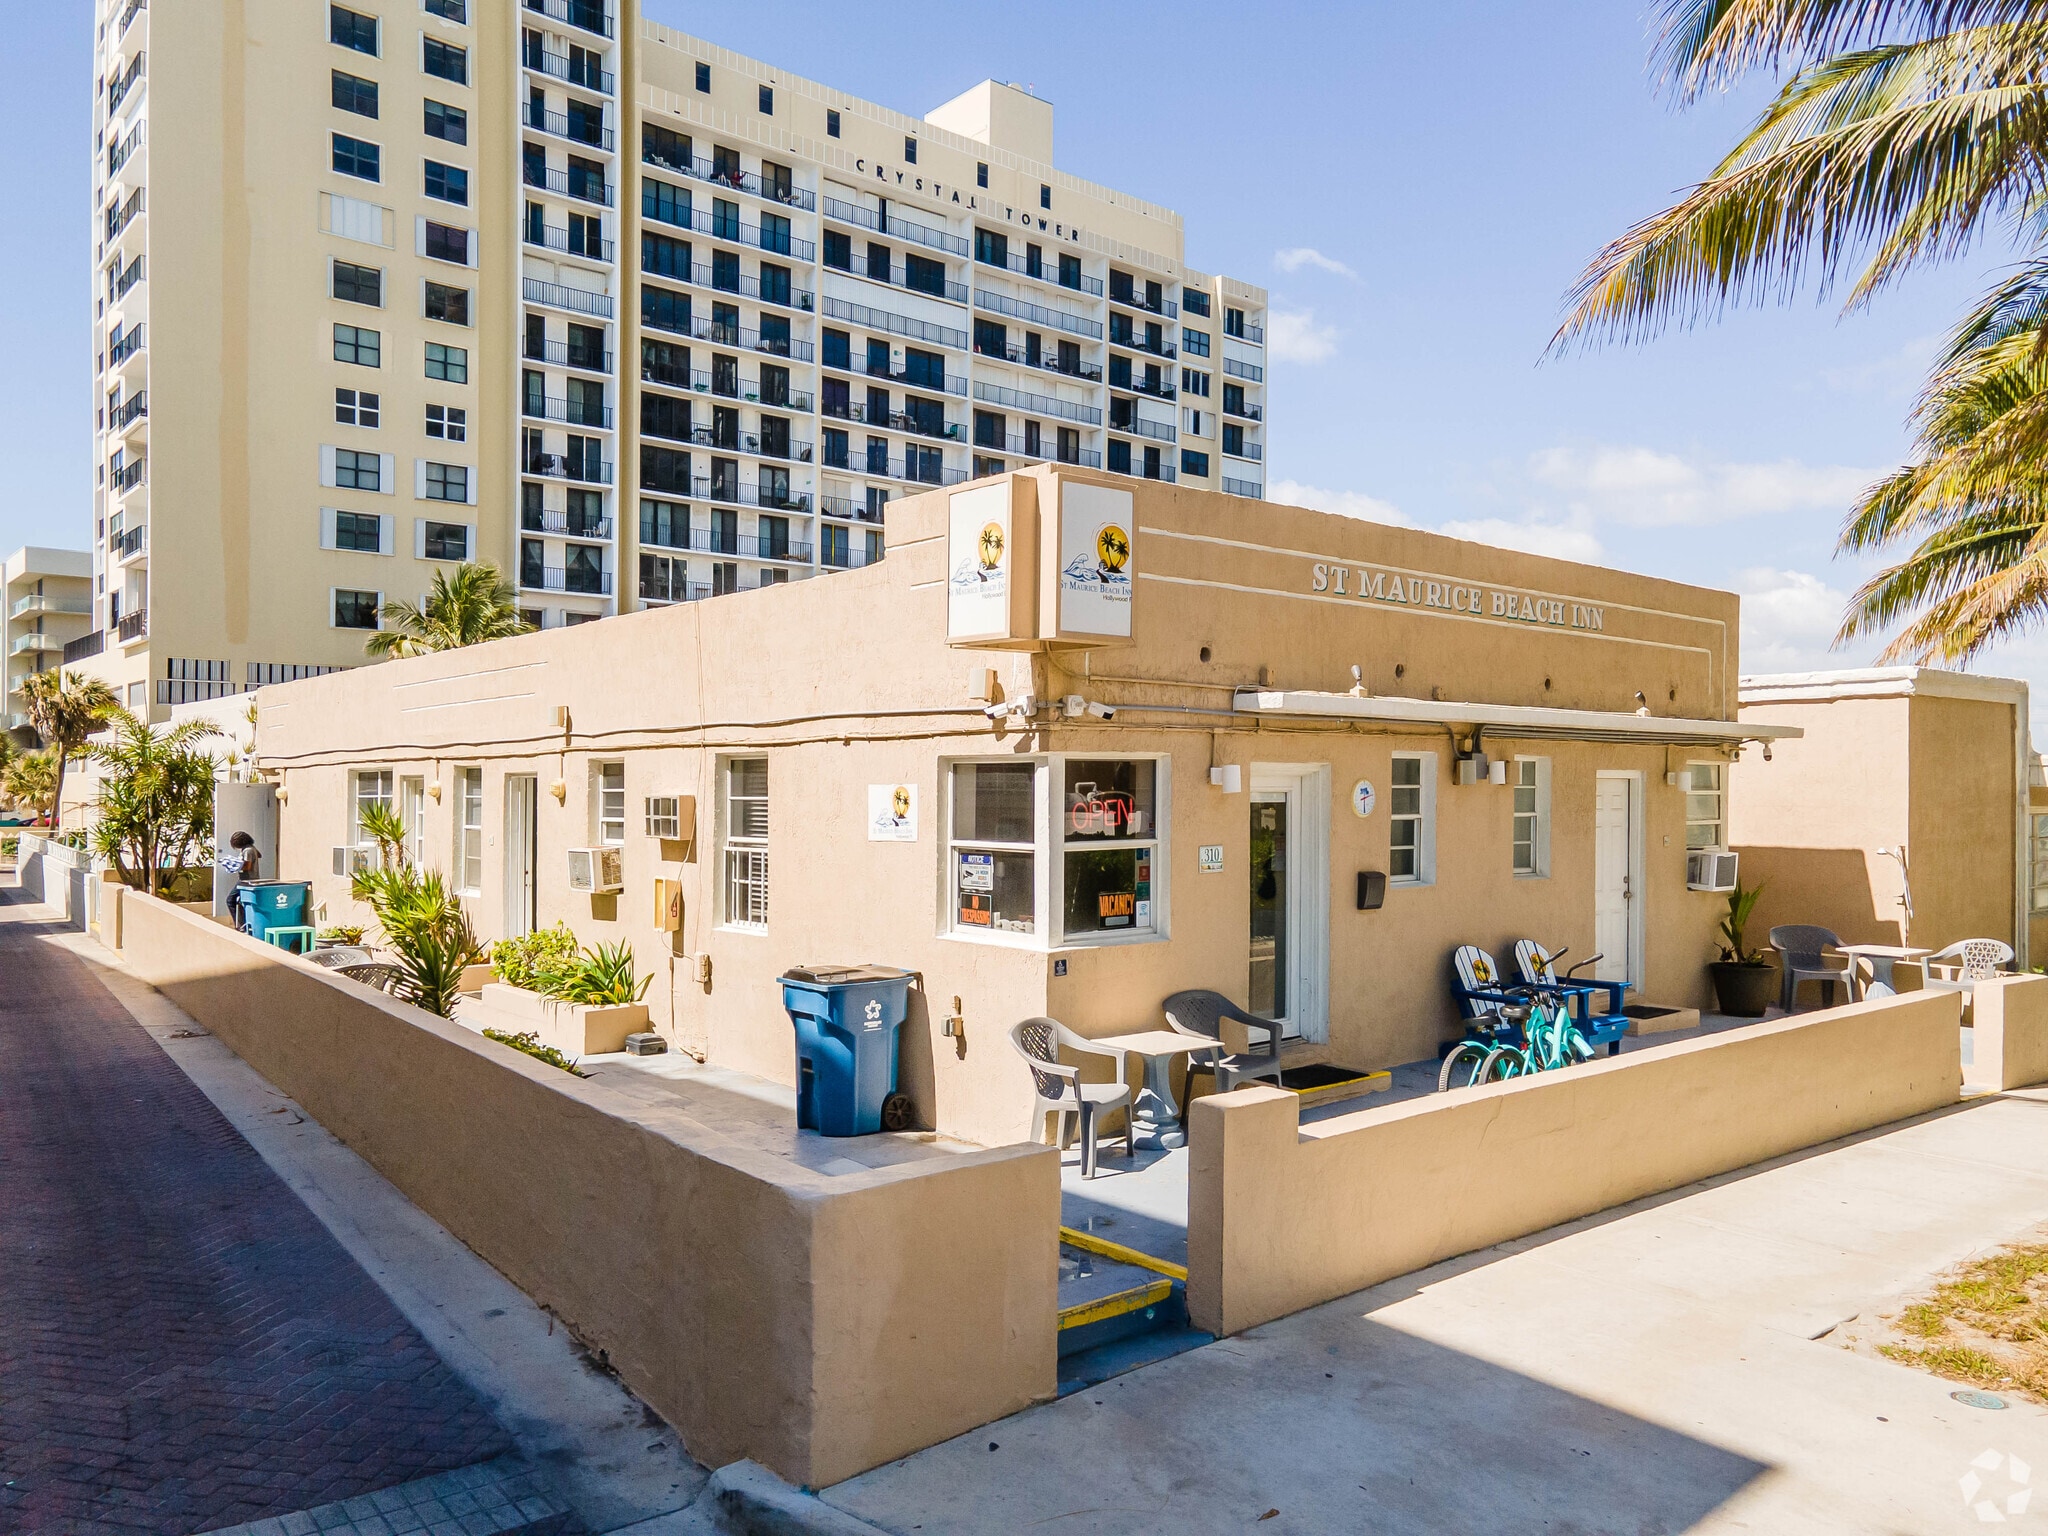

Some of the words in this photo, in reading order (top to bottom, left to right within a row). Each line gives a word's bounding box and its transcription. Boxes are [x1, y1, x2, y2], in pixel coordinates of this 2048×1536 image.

[856, 159, 976, 209] CRYSTAL
[1005, 207, 1079, 242] TOWER
[1103, 594, 1128, 602] Hollywood
[1357, 569, 1482, 614] MAURICE
[1490, 591, 1565, 625] BEACH
[1571, 603, 1604, 630] INN
[1072, 798, 1133, 829] OPEN
[967, 855, 985, 864] NOTICE
[1204, 848, 1220, 862] 310
[1099, 894, 1135, 917] VACANCY
